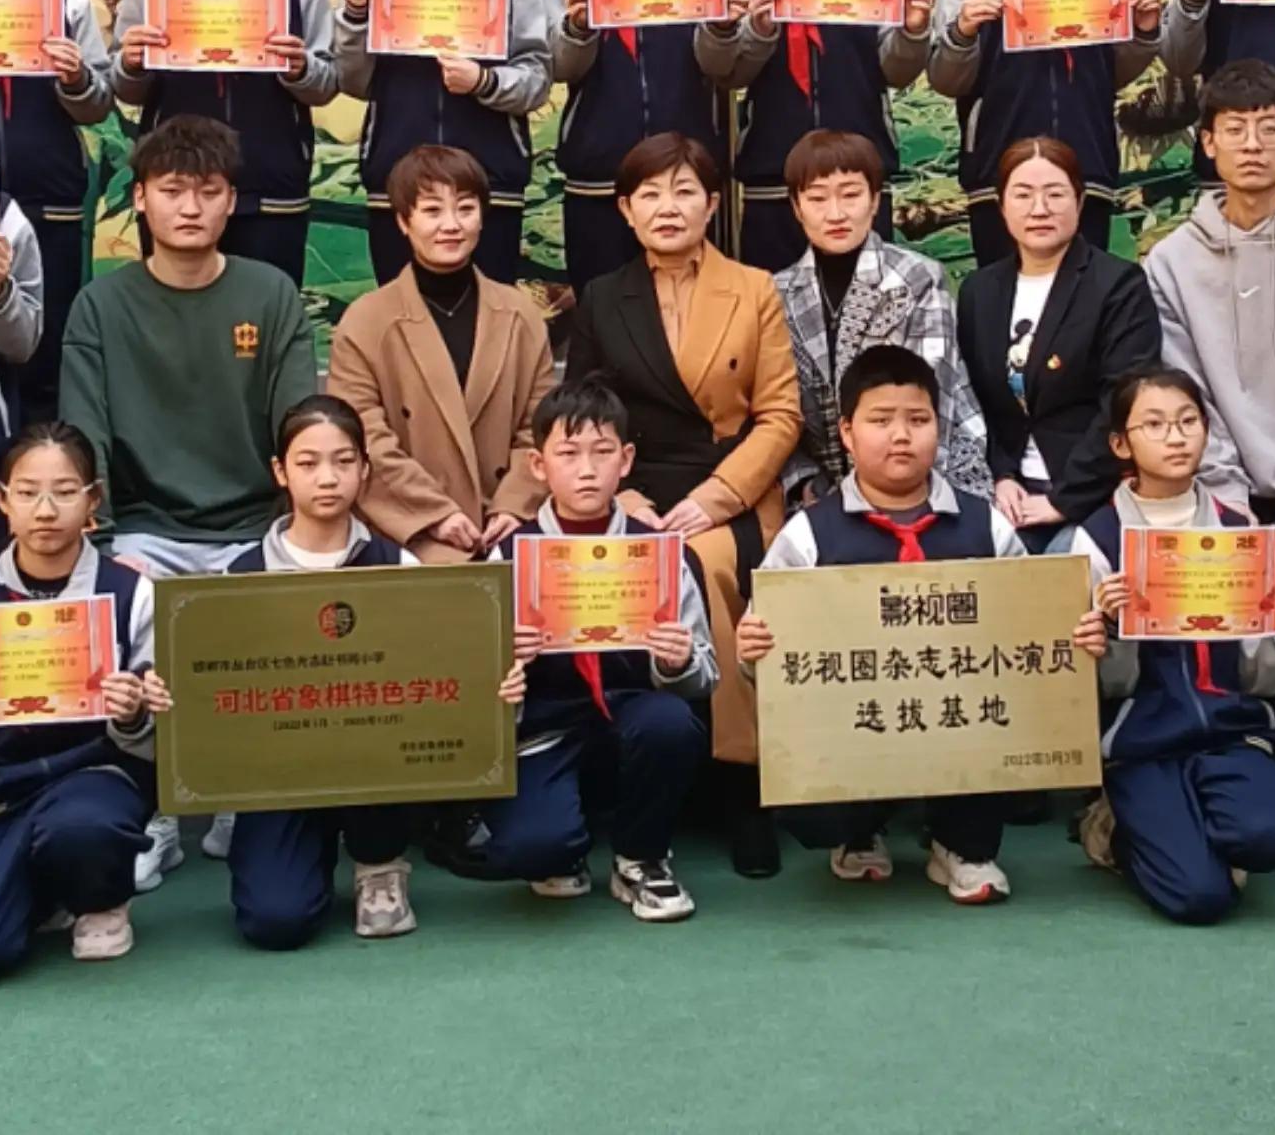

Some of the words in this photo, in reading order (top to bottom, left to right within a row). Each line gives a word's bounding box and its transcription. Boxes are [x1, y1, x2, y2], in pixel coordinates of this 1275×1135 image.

[880, 592, 979, 628] 影视圈
[782, 639, 1077, 685] 影视圈杂志社小演员
[213, 677, 461, 715] 河北省象棋特色学校
[853, 694, 1011, 733] 选拔基地
